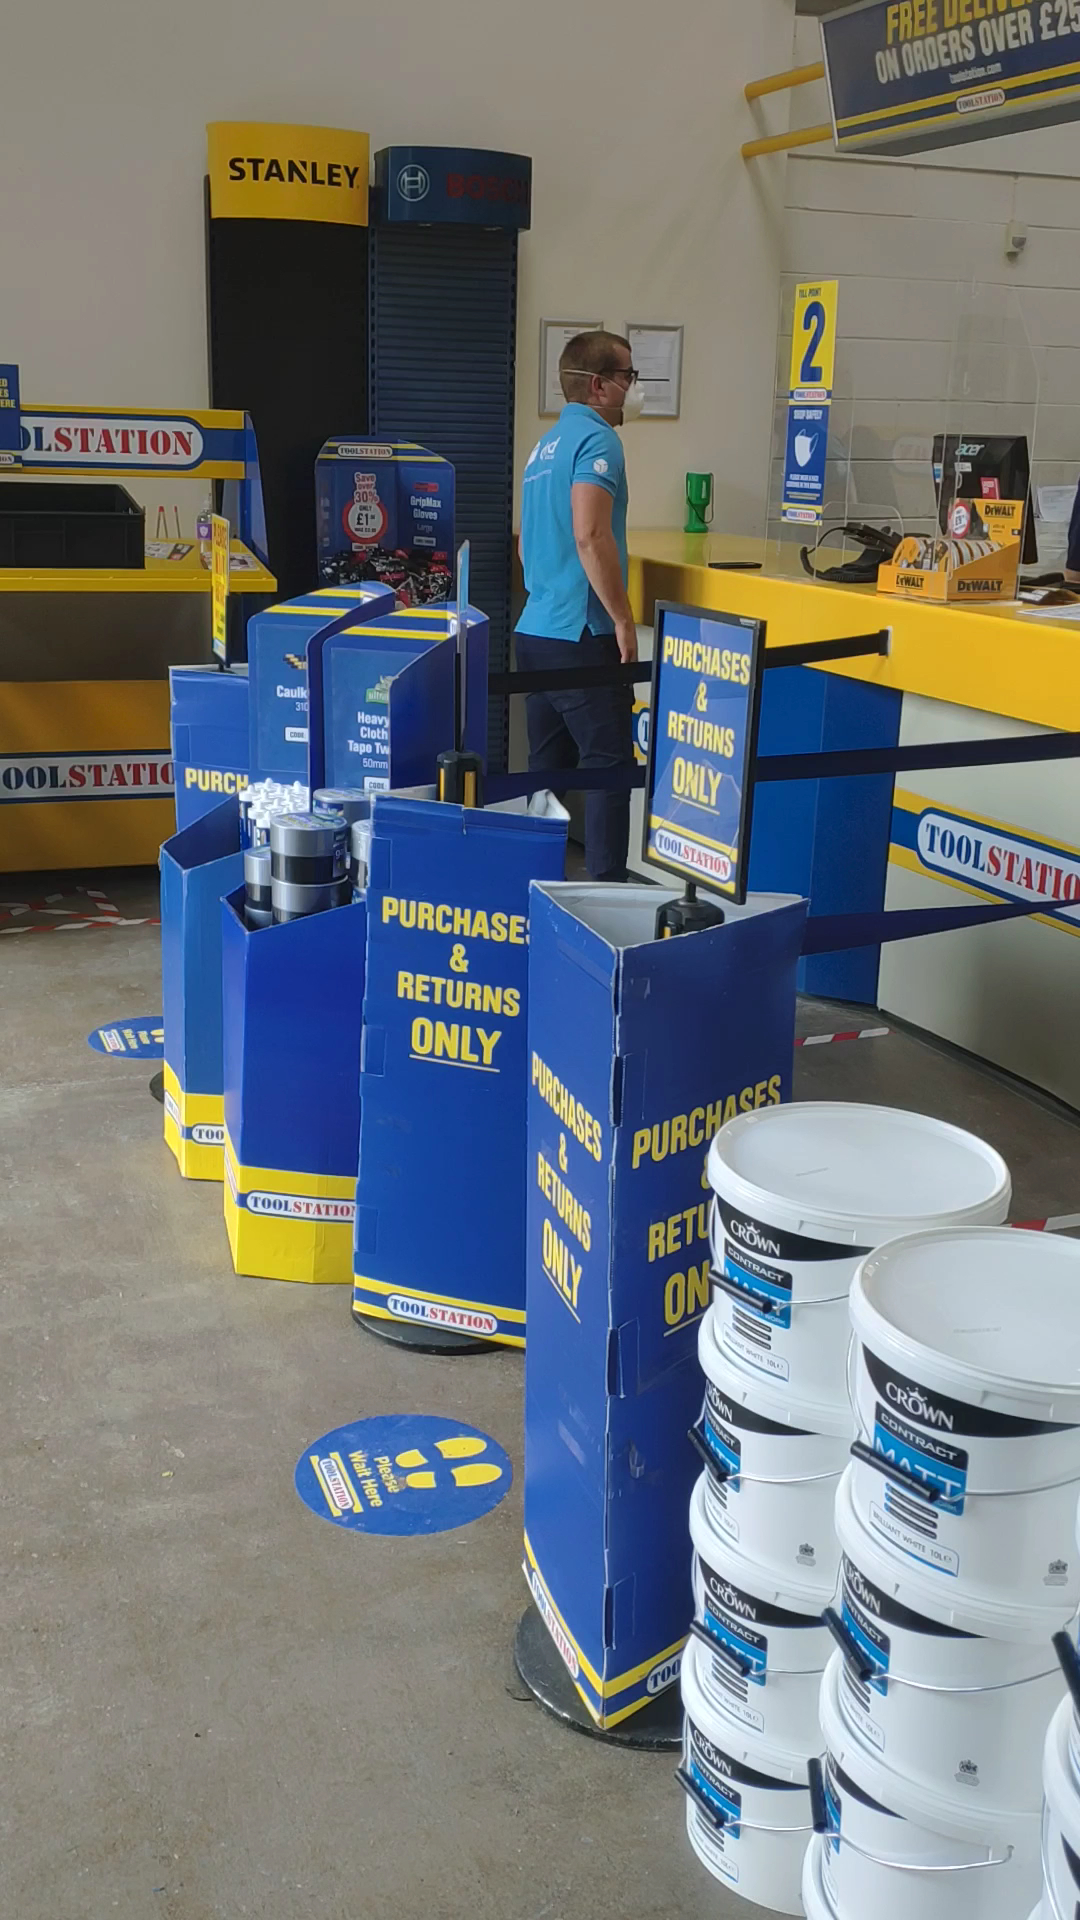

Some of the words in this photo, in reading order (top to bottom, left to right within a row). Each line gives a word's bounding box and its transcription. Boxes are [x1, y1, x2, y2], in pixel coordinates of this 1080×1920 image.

[886, 0, 937, 45] FREE
[875, 47, 900, 84] ON
[902, 24, 976, 76] ORDERS
[978, 9, 1034, 56] OVER
[958, 91, 1003, 110] TOOLSTATION
[229, 157, 360, 189] STANLEY
[446, 173, 529, 206] BOSCH
[800, 300, 826, 383] 2
[340, 447, 391, 456] TOOLSTATION
[955, 443, 984, 456] acer
[355, 473, 376, 482] Save
[355, 491, 378, 503] 30%
[357, 483, 374, 491] over
[410, 496, 442, 509] GripMax
[413, 508, 438, 521] Gloves
[662, 635, 751, 686] PURCHASES
[695, 682, 708, 713] &
[357, 711, 389, 728] Heavy
[360, 726, 388, 740] Cloth
[667, 710, 735, 759] RETURNS
[347, 740, 373, 755] Tape
[362, 758, 388, 769] 50mm
[672, 756, 724, 807] ONLY
[657, 832, 730, 877] TOOLSTATION
[381, 896, 530, 945] PURCHASE
[449, 943, 469, 973] &
[397, 970, 521, 1017] RETURNS
[411, 1016, 503, 1066] ONLY
[531, 1050, 603, 1162] PURCHASES
[631, 1074, 782, 1170] PURCHASES
[558, 1131, 568, 1174] &
[537, 1151, 592, 1252] RETURNS
[730, 1219, 781, 1258] CROWN
[542, 1217, 583, 1309] ONLY
[727, 1246, 785, 1283] CONTRACT
[390, 1298, 494, 1331] TOOLSTATION
[886, 1382, 954, 1431] CROWN
[881, 1412, 958, 1461] CONTRACT
[321, 1459, 351, 1509] TOOLSTATION
[348, 1449, 372, 1479] Wait
[360, 1477, 384, 1508] Here
[373, 1455, 400, 1494] Please
[902, 1534, 927, 1553] WHITE
[709, 1577, 757, 1620] CROWN
[707, 1600, 761, 1644] CONTRACT
[694, 1729, 732, 1777] CROWN
